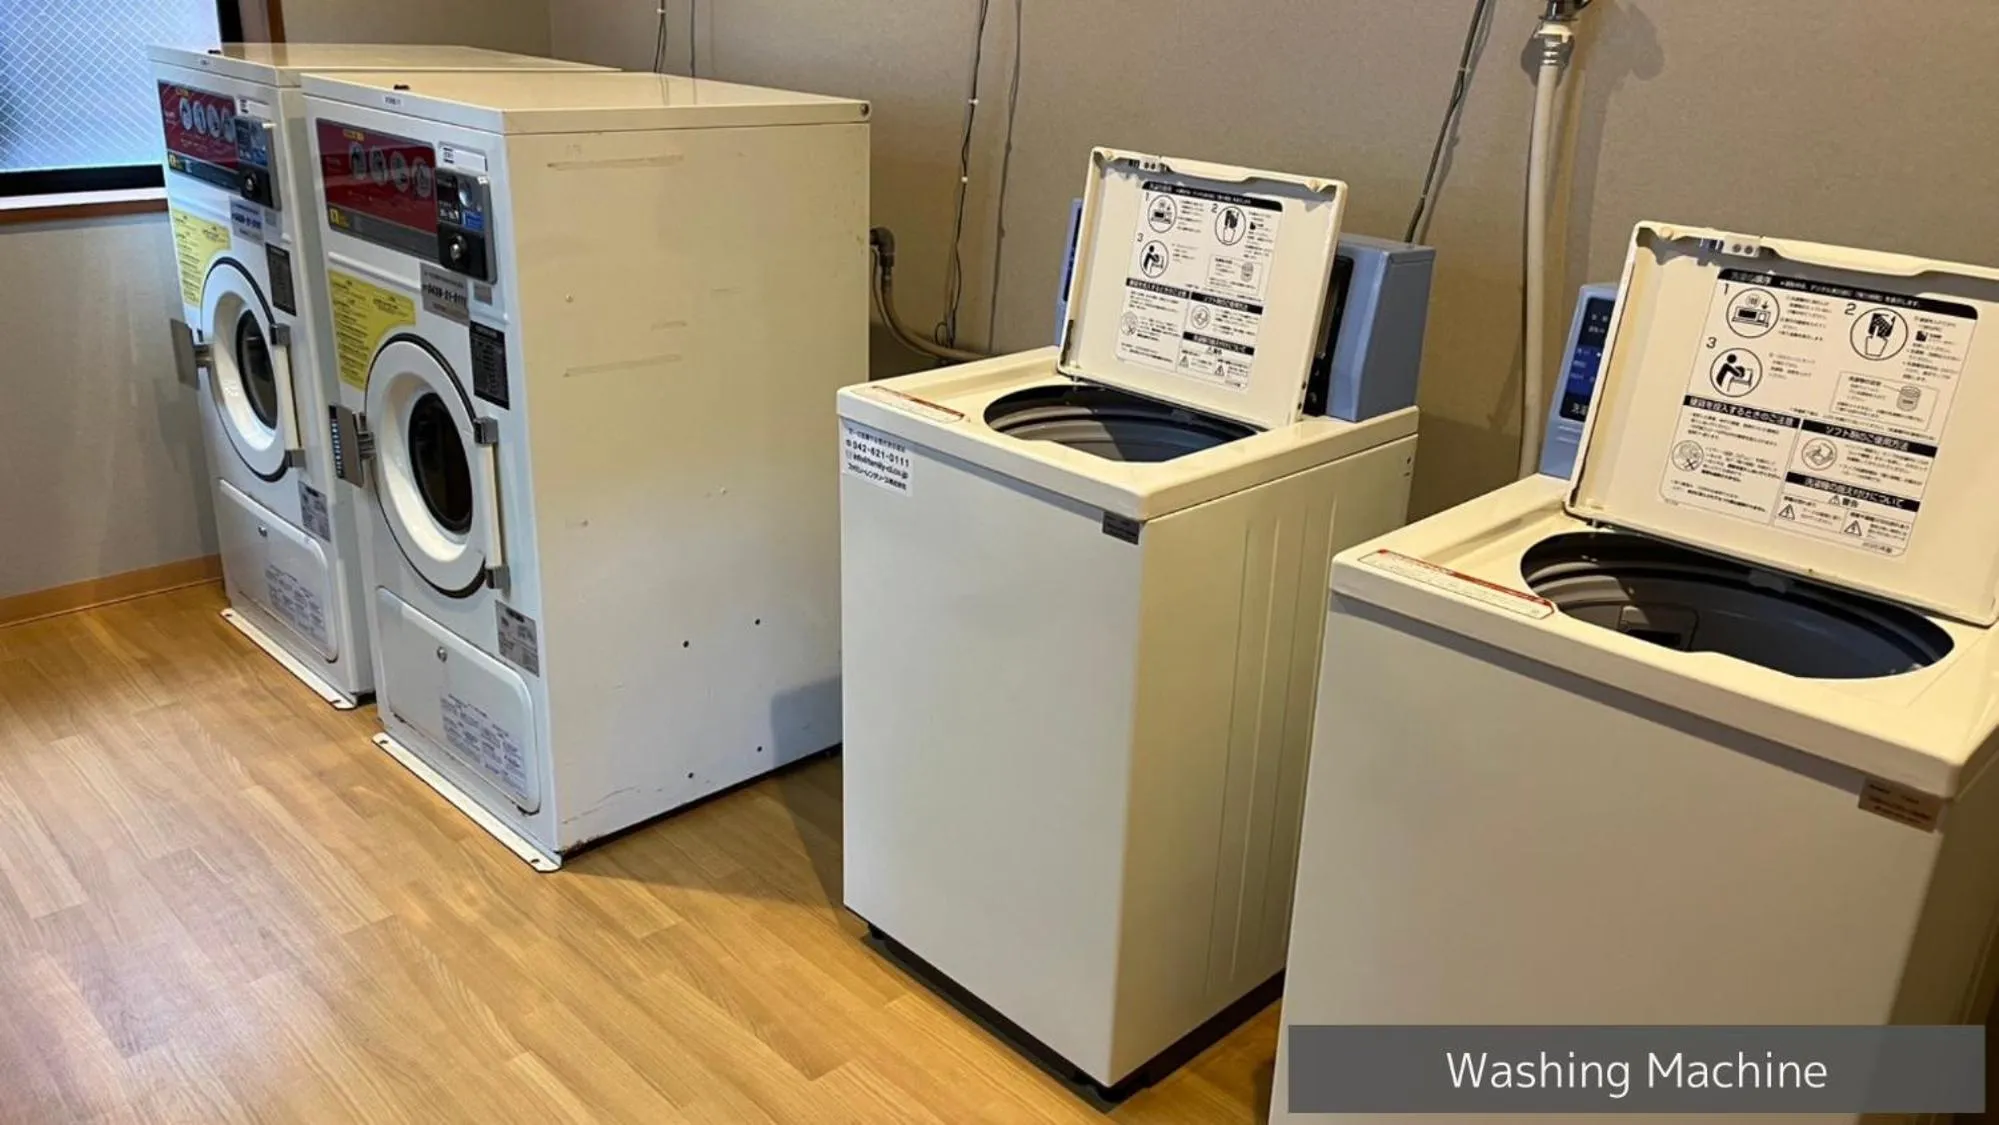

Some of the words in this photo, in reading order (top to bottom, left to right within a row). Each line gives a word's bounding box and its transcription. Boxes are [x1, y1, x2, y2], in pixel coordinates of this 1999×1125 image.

[1211, 203, 1219, 213] 2
[1136, 233, 1144, 242] 3
[1723, 283, 1729, 296] 1
[1844, 302, 1857, 316] 2
[1706, 336, 1717, 349] 3
[852, 440, 909, 467] 042-621-0111
